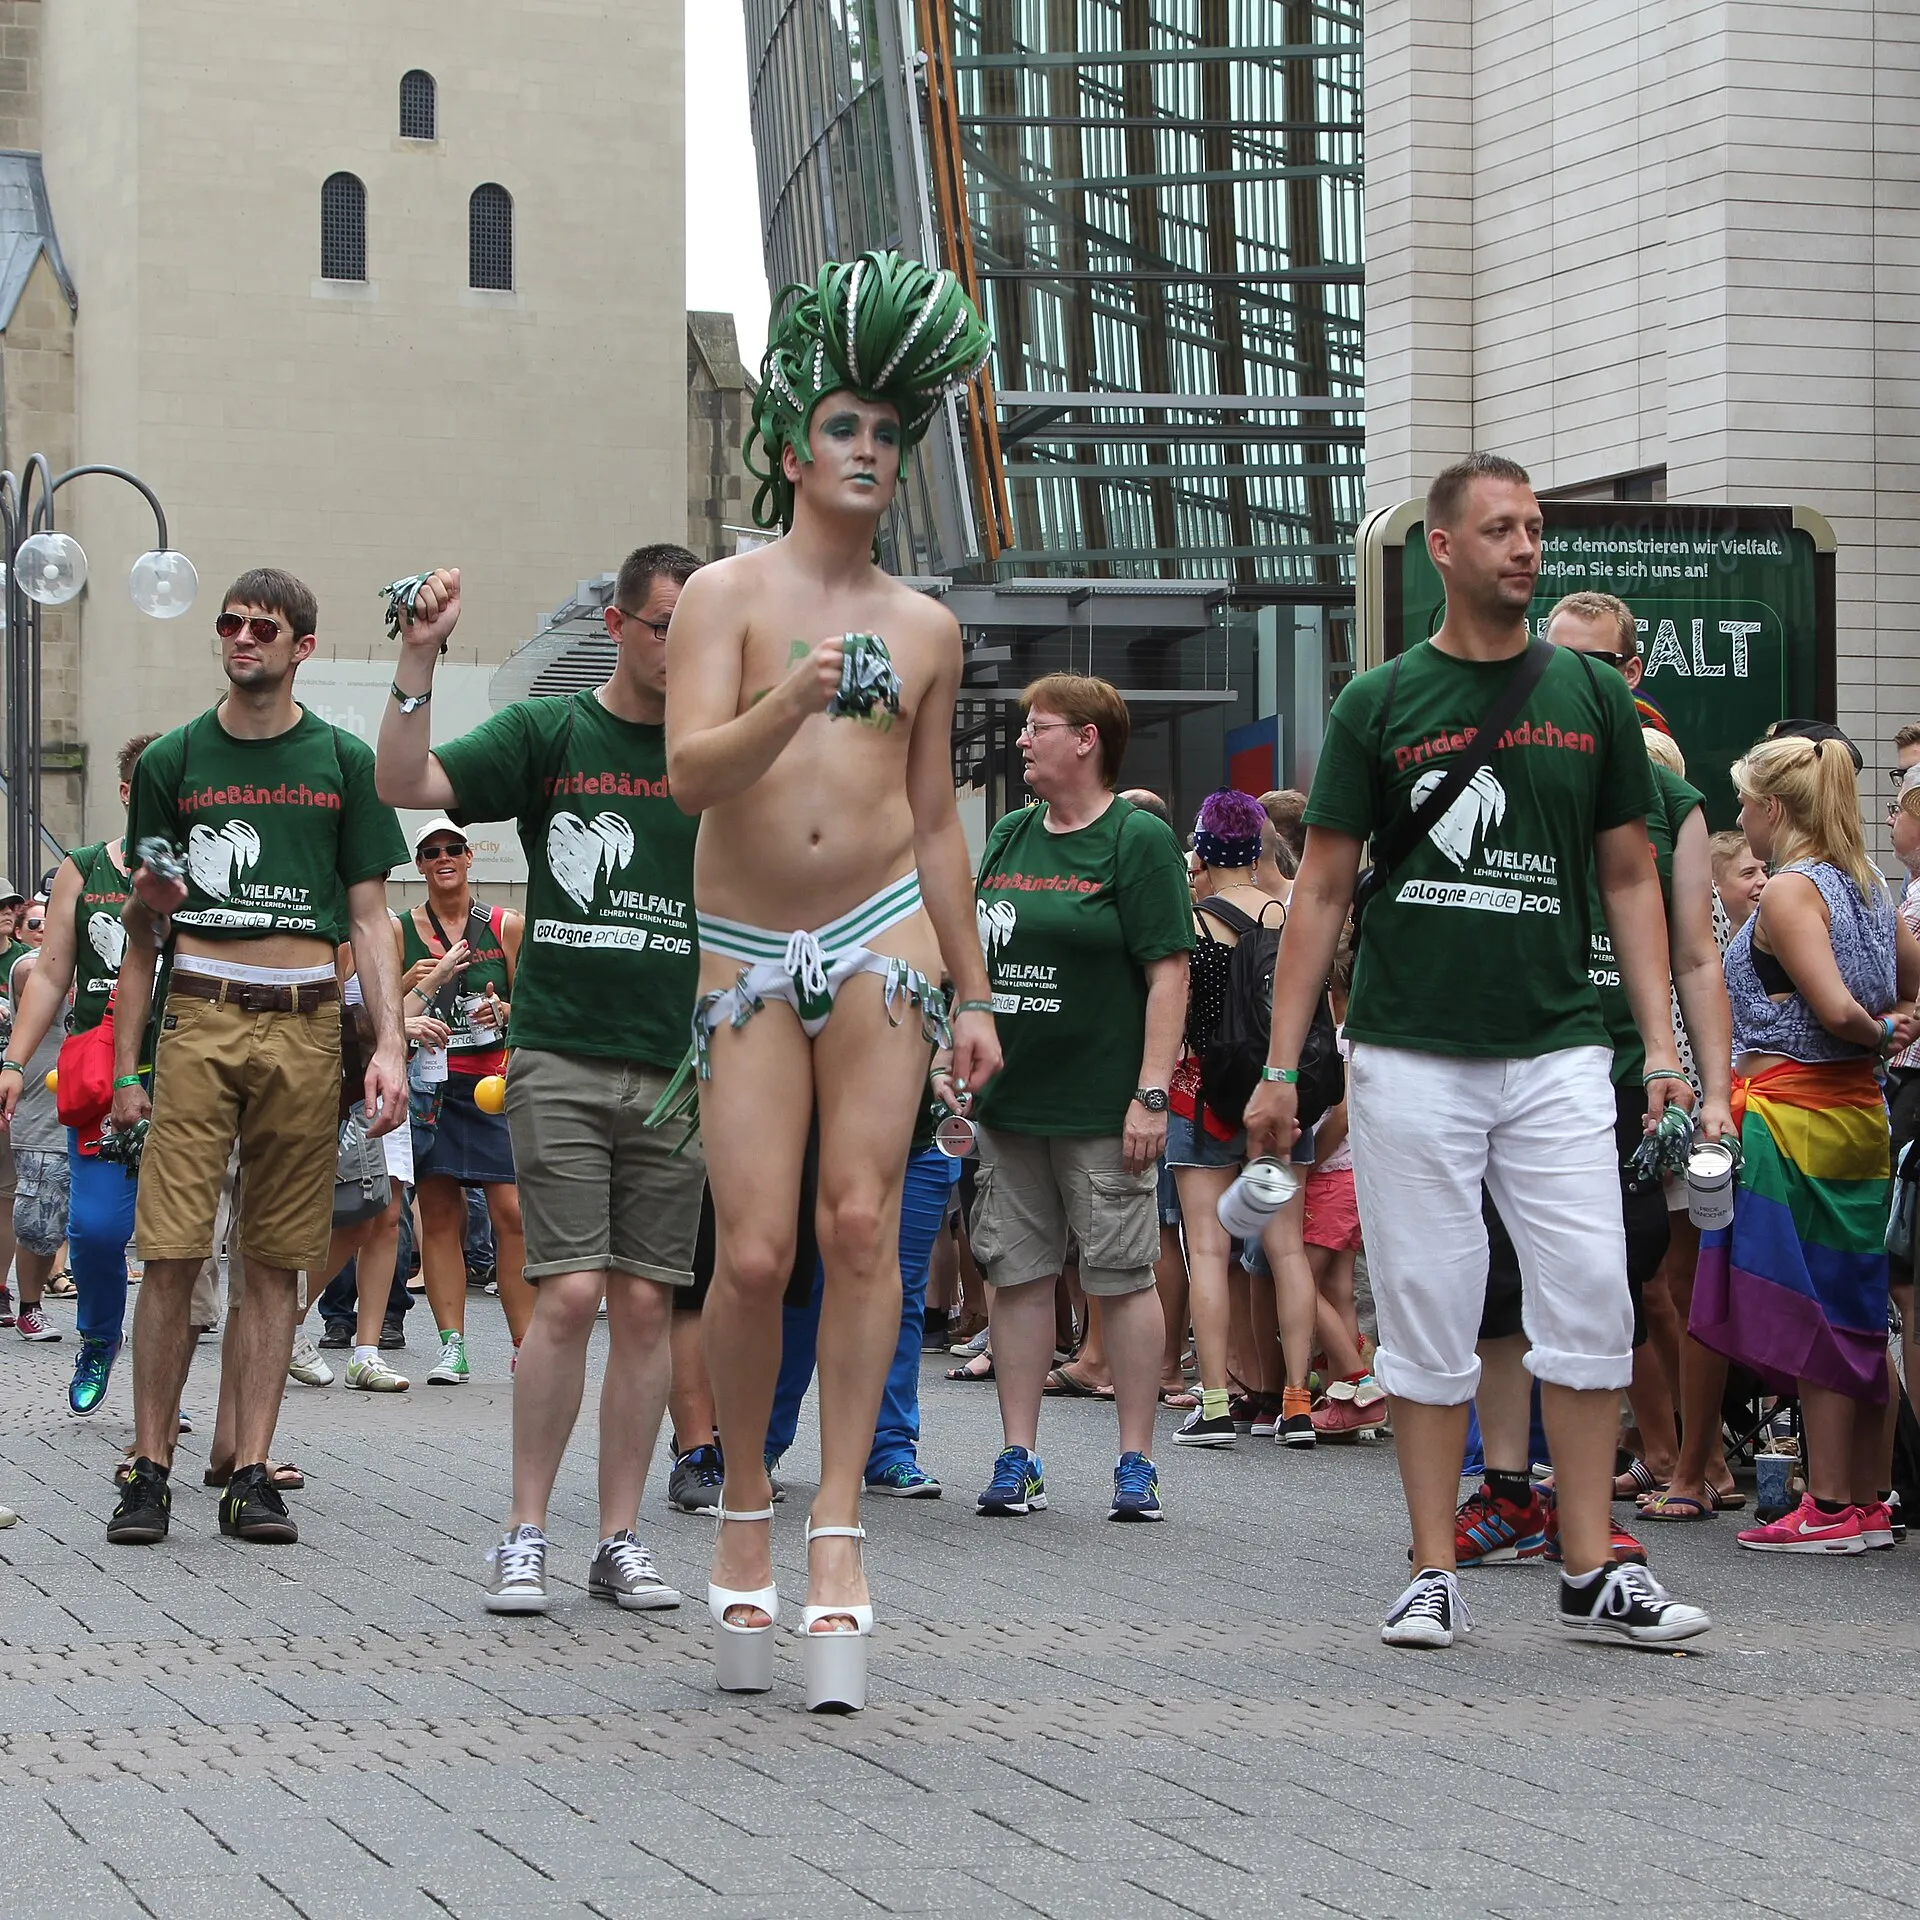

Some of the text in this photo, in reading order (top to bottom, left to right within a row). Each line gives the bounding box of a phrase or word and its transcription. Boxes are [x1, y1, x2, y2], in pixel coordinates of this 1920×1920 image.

[1572, 536, 1689, 554] demonstrieren
[1692, 539, 1718, 554] wir
[1721, 539, 1782, 556] Vielfalt.
[1590, 561, 1614, 577] Sie
[1617, 560, 1648, 577] sich
[1651, 565, 1681, 578] uns
[1684, 562, 1709, 578] an!
[1483, 847, 1557, 874] VIELFALT
[1473, 867, 1503, 878] LEHREN
[1510, 872, 1536, 883] LERNEN
[240, 883, 310, 903] VIELFALT
[1402, 883, 1561, 915] cologne pride 2015
[230, 897, 312, 911] LEHREN LERNEN LEBEN
[609, 889, 686, 919] VIELFALT
[225, 912, 267, 927] pride
[275, 916, 317, 931] 2015
[599, 908, 688, 929] LEHREN LERNEN LEBEN
[536, 919, 692, 955] cologne pride 2015
[175, 959, 247, 977] REVIEW
[997, 962, 1057, 981] VIELFALT
[1013, 980, 1034, 988] LERNEN
[1039, 982, 1058, 990] LEBEN
[1021, 996, 1062, 1013] 2015
